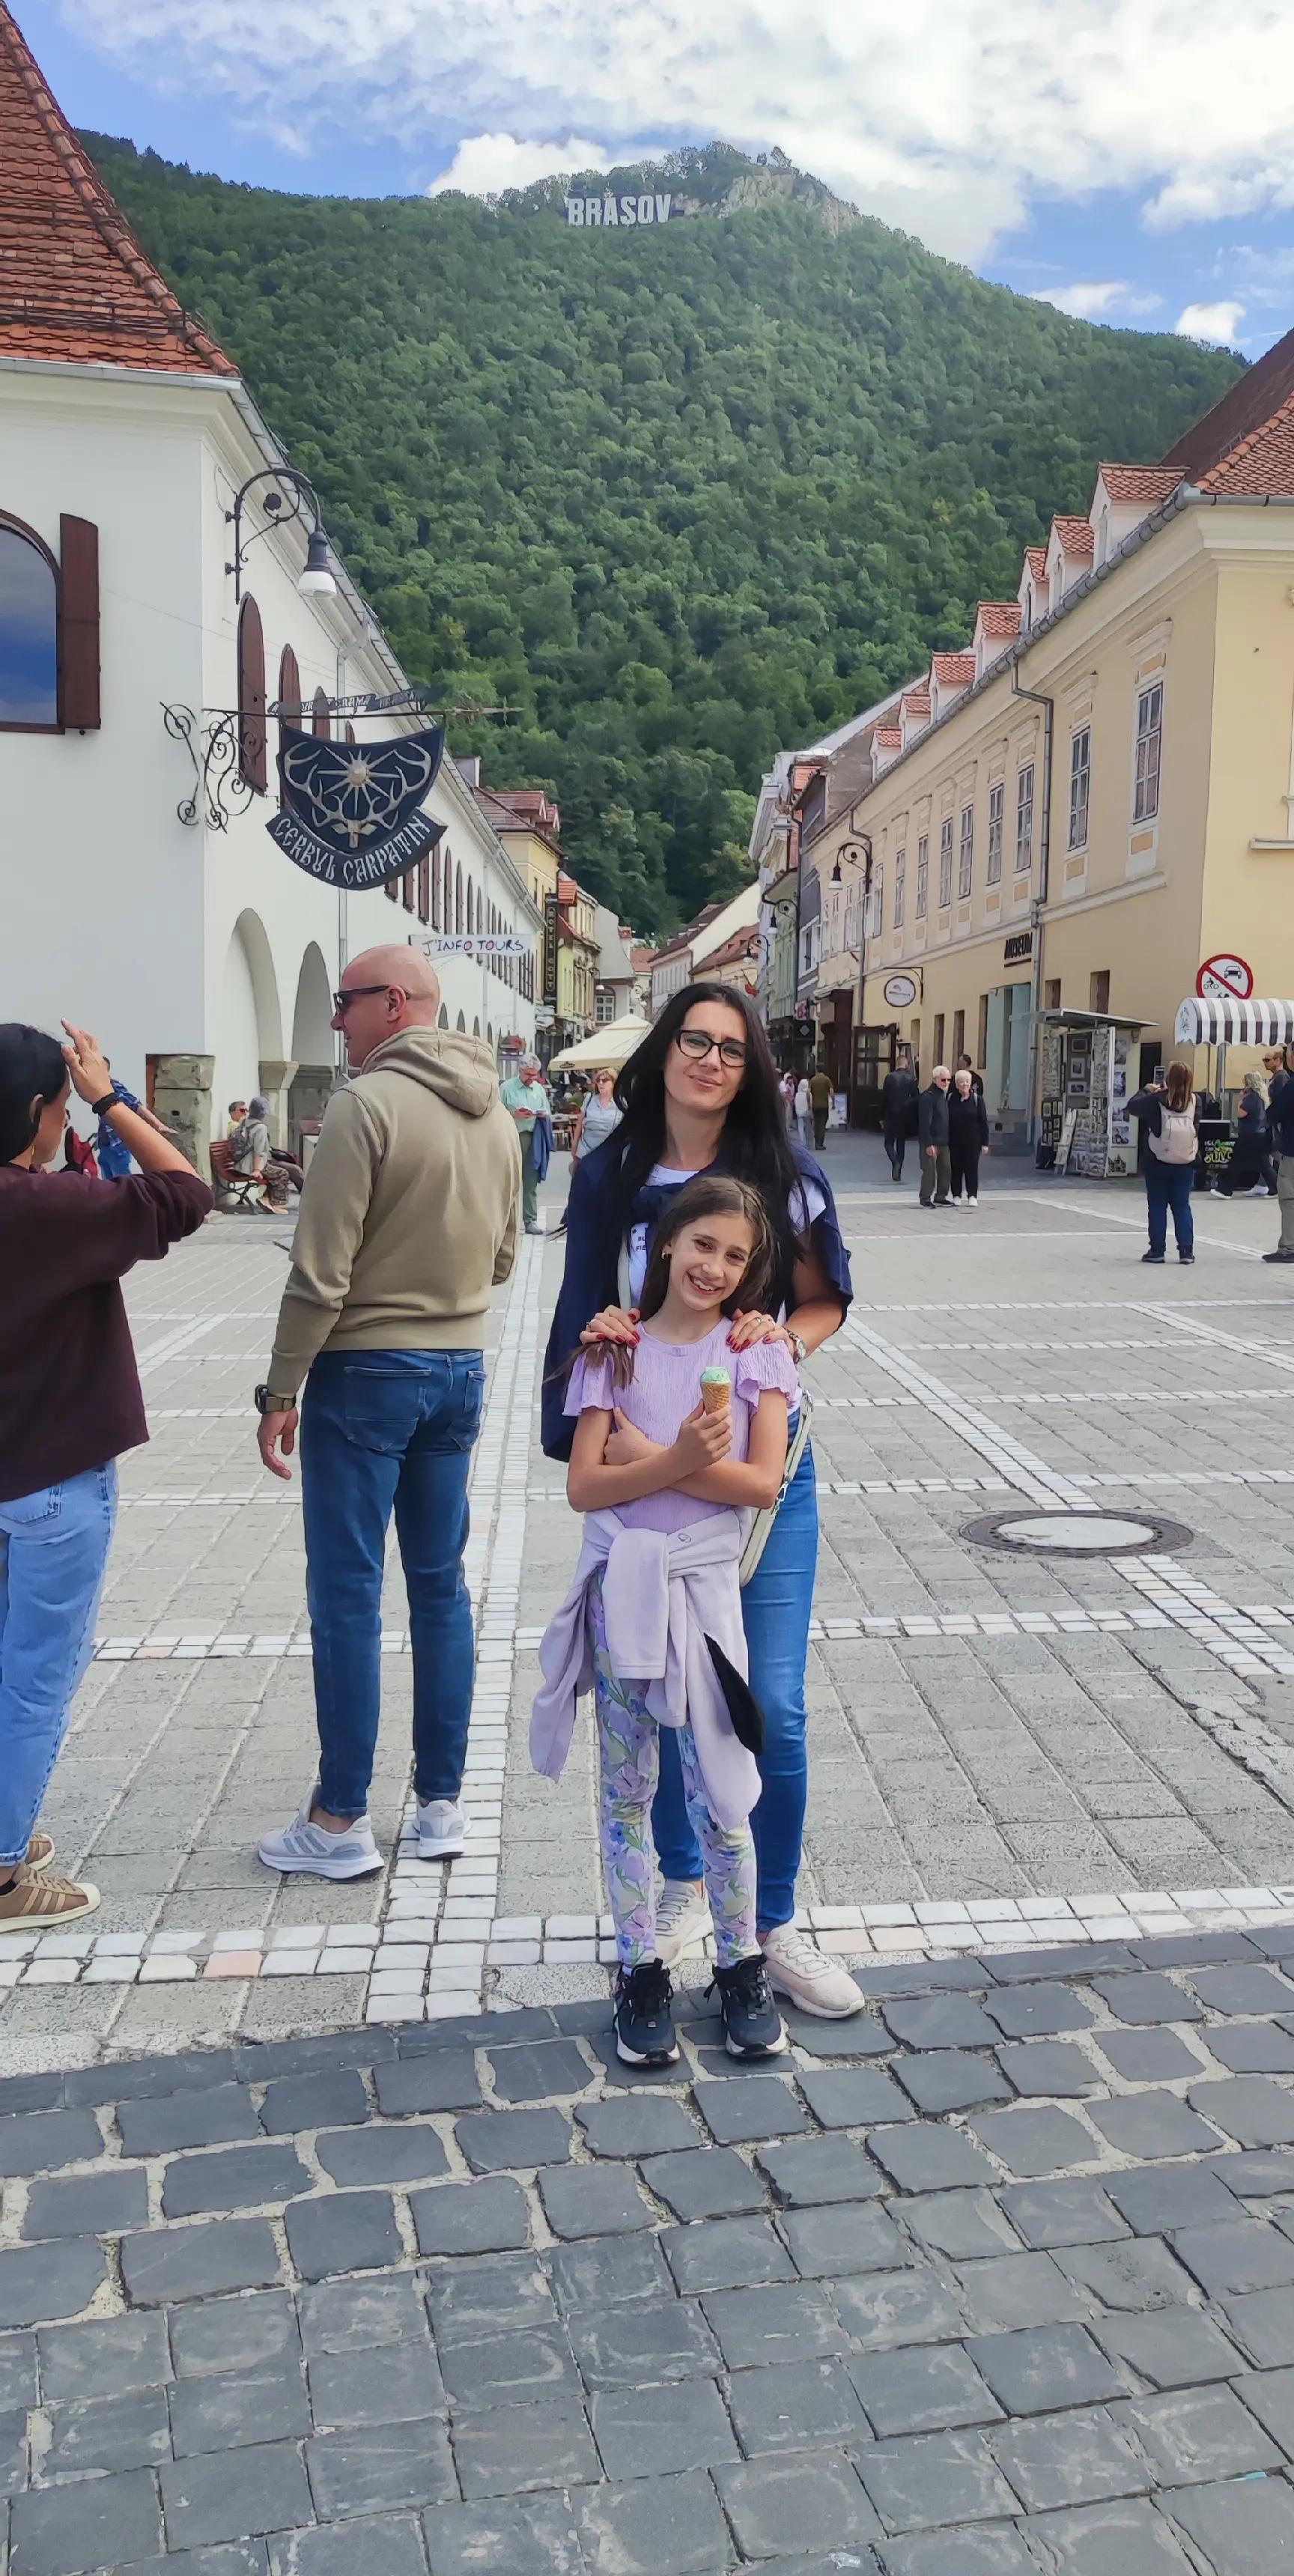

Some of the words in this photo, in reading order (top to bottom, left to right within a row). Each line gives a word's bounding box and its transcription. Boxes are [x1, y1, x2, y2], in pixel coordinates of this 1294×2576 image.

[568, 193, 672, 226] BRASOV
[274, 818, 336, 881] CERBUL
[342, 815, 431, 885] CARPATIN
[477, 939, 524, 952] TOURS
